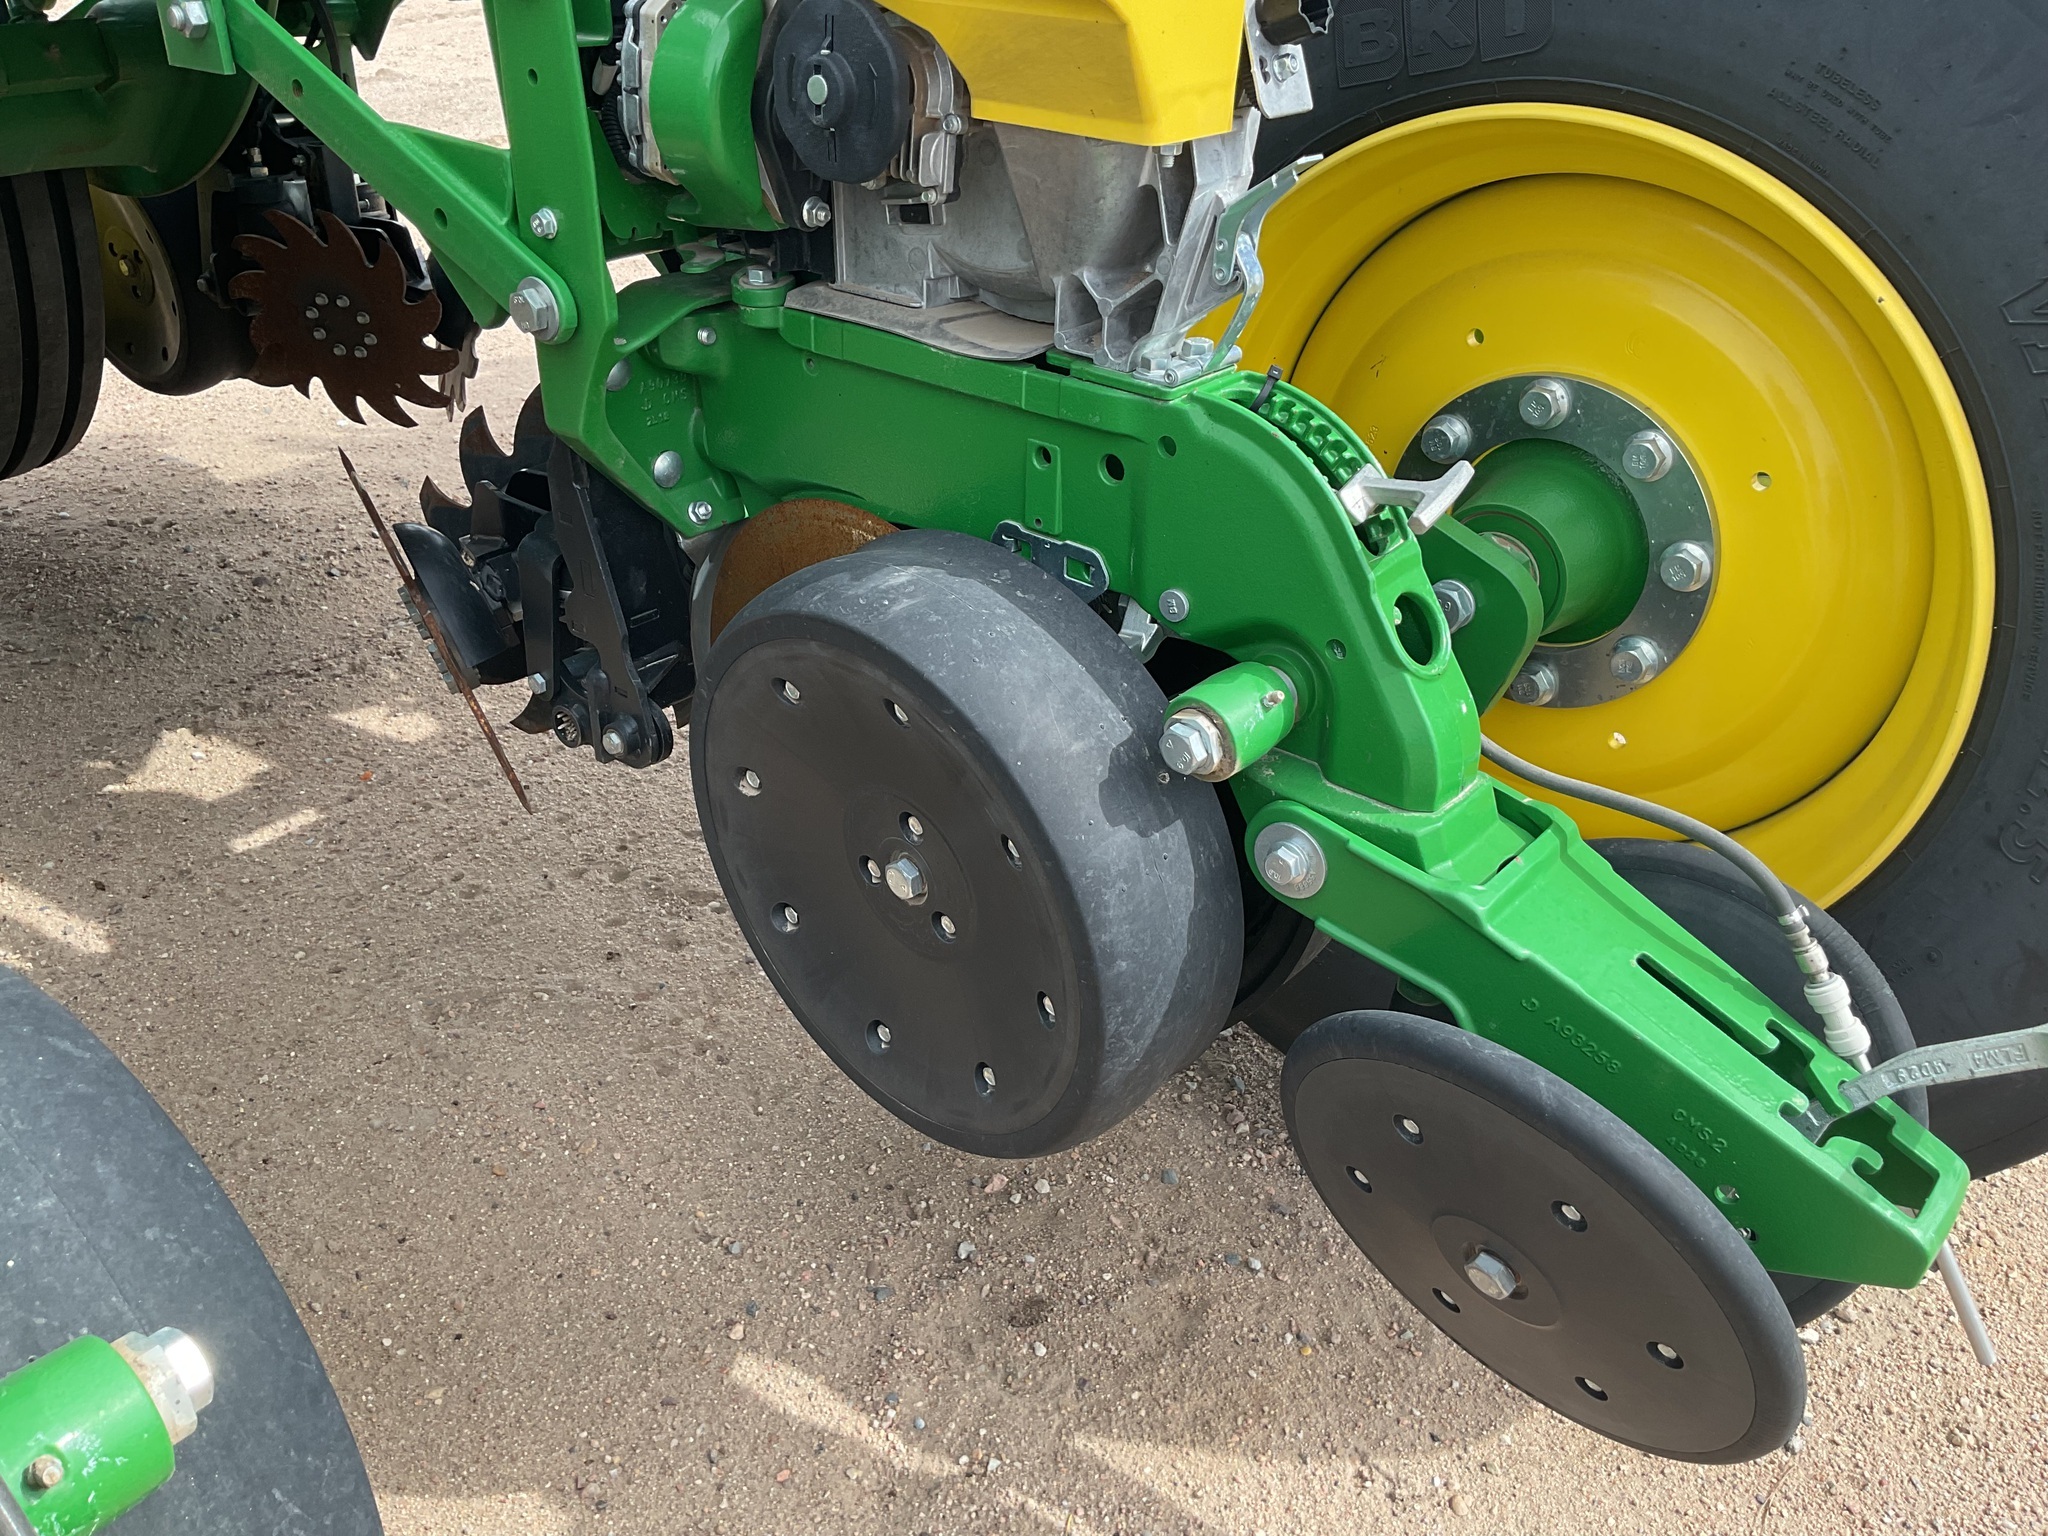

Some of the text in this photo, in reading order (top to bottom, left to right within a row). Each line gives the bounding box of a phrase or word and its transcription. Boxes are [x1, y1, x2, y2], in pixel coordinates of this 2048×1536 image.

[1815, 62, 1881, 111] TUBELESS
[1767, 88, 1880, 169] ALL STEEL RADIAL
[2022, 510, 2046, 699] NOT FOR HIGHWAY SERVICE
